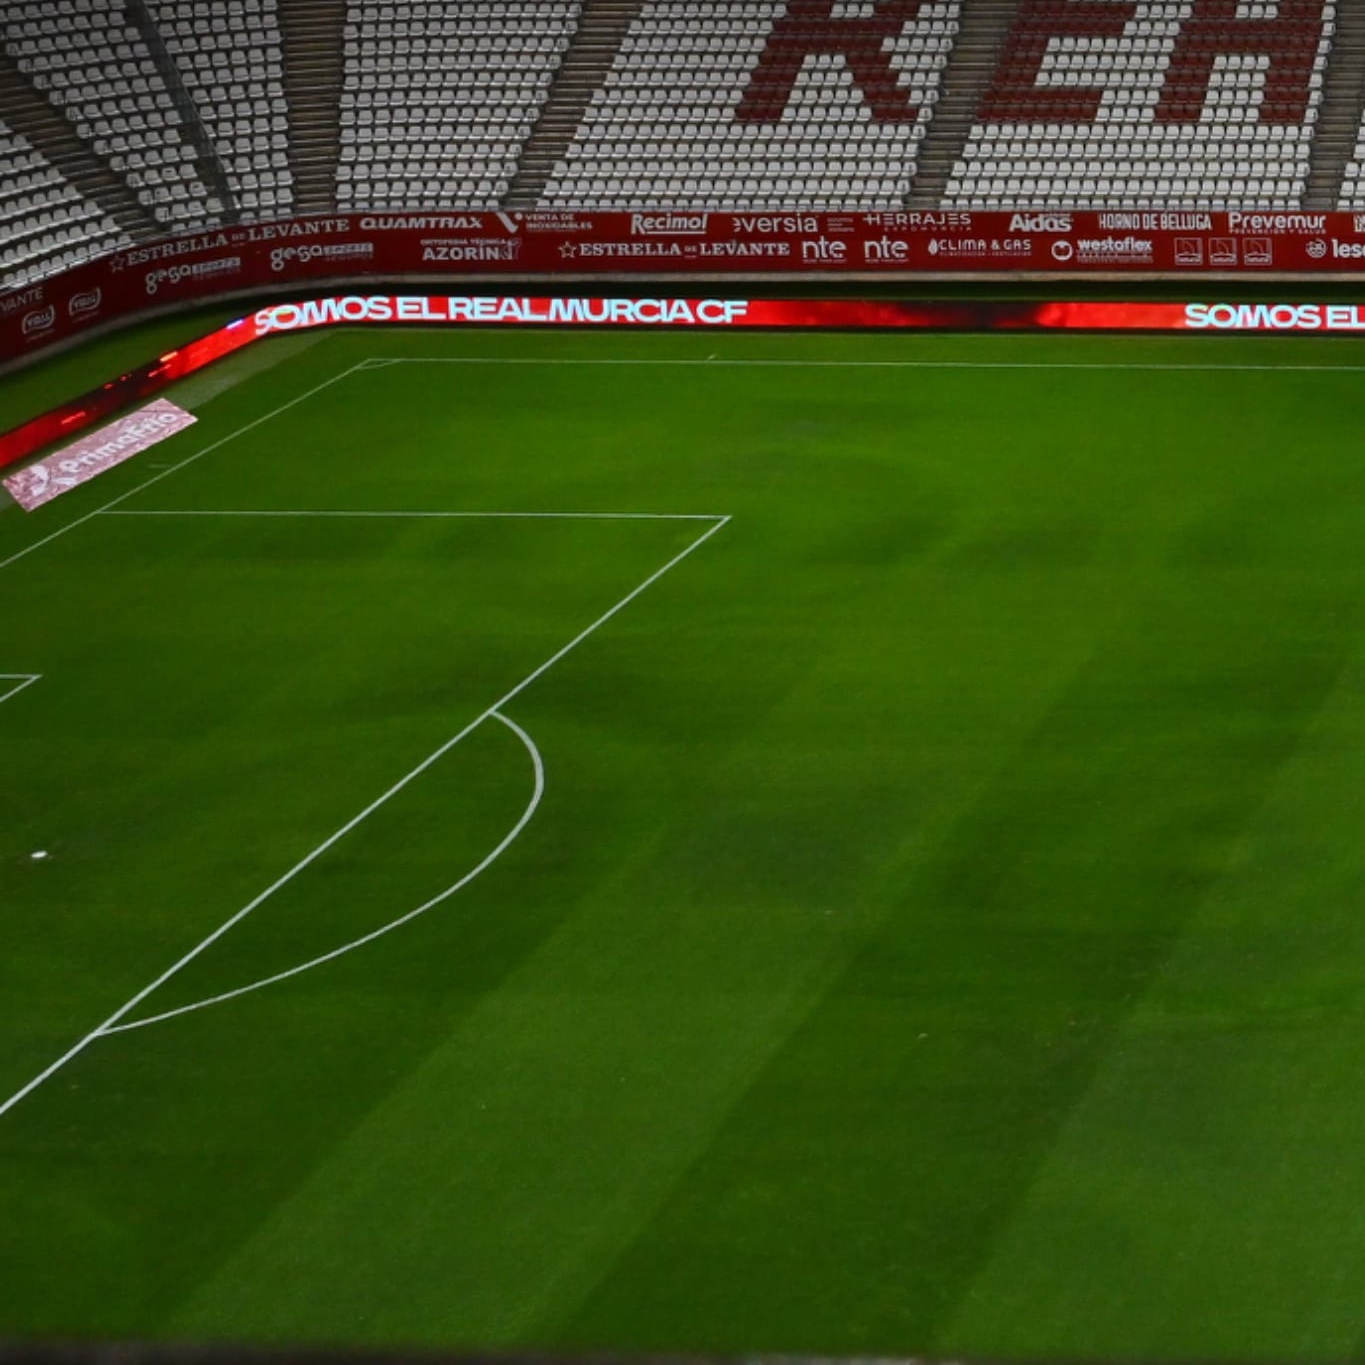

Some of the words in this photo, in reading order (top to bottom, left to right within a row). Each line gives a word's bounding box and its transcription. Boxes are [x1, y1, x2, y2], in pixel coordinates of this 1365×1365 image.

[360, 217, 482, 230] QUAMTRAX
[631, 213, 708, 234] Recimol
[863, 213, 971, 225] HERRAJES
[1009, 214, 1071, 232] Aidas
[1099, 213, 1140, 230] HORNO
[1143, 214, 1158, 230] DE
[1160, 213, 1212, 230] BELLUGA
[1229, 212, 1326, 228] Prevemur
[127, 233, 228, 266] ESTRELLA
[248, 218, 350, 241] LEVANTE
[579, 242, 681, 256] ESTRELLA
[699, 241, 790, 256] LEVANTE
[802, 235, 846, 258] nte
[864, 235, 909, 258] nte
[939, 239, 986, 250] CLIMA
[991, 239, 999, 250] &
[1003, 239, 1032, 250] GAS
[1077, 236, 1152, 252] westaflex
[271, 244, 325, 271] gesa
[422, 245, 500, 260] AZORÍN
[254, 296, 391, 335] SOMOS
[397, 296, 446, 321] EL
[449, 297, 546, 322] REAL
[551, 298, 695, 323] MURCIA
[697, 299, 748, 324] CF
[1184, 303, 1321, 329] SOMOS
